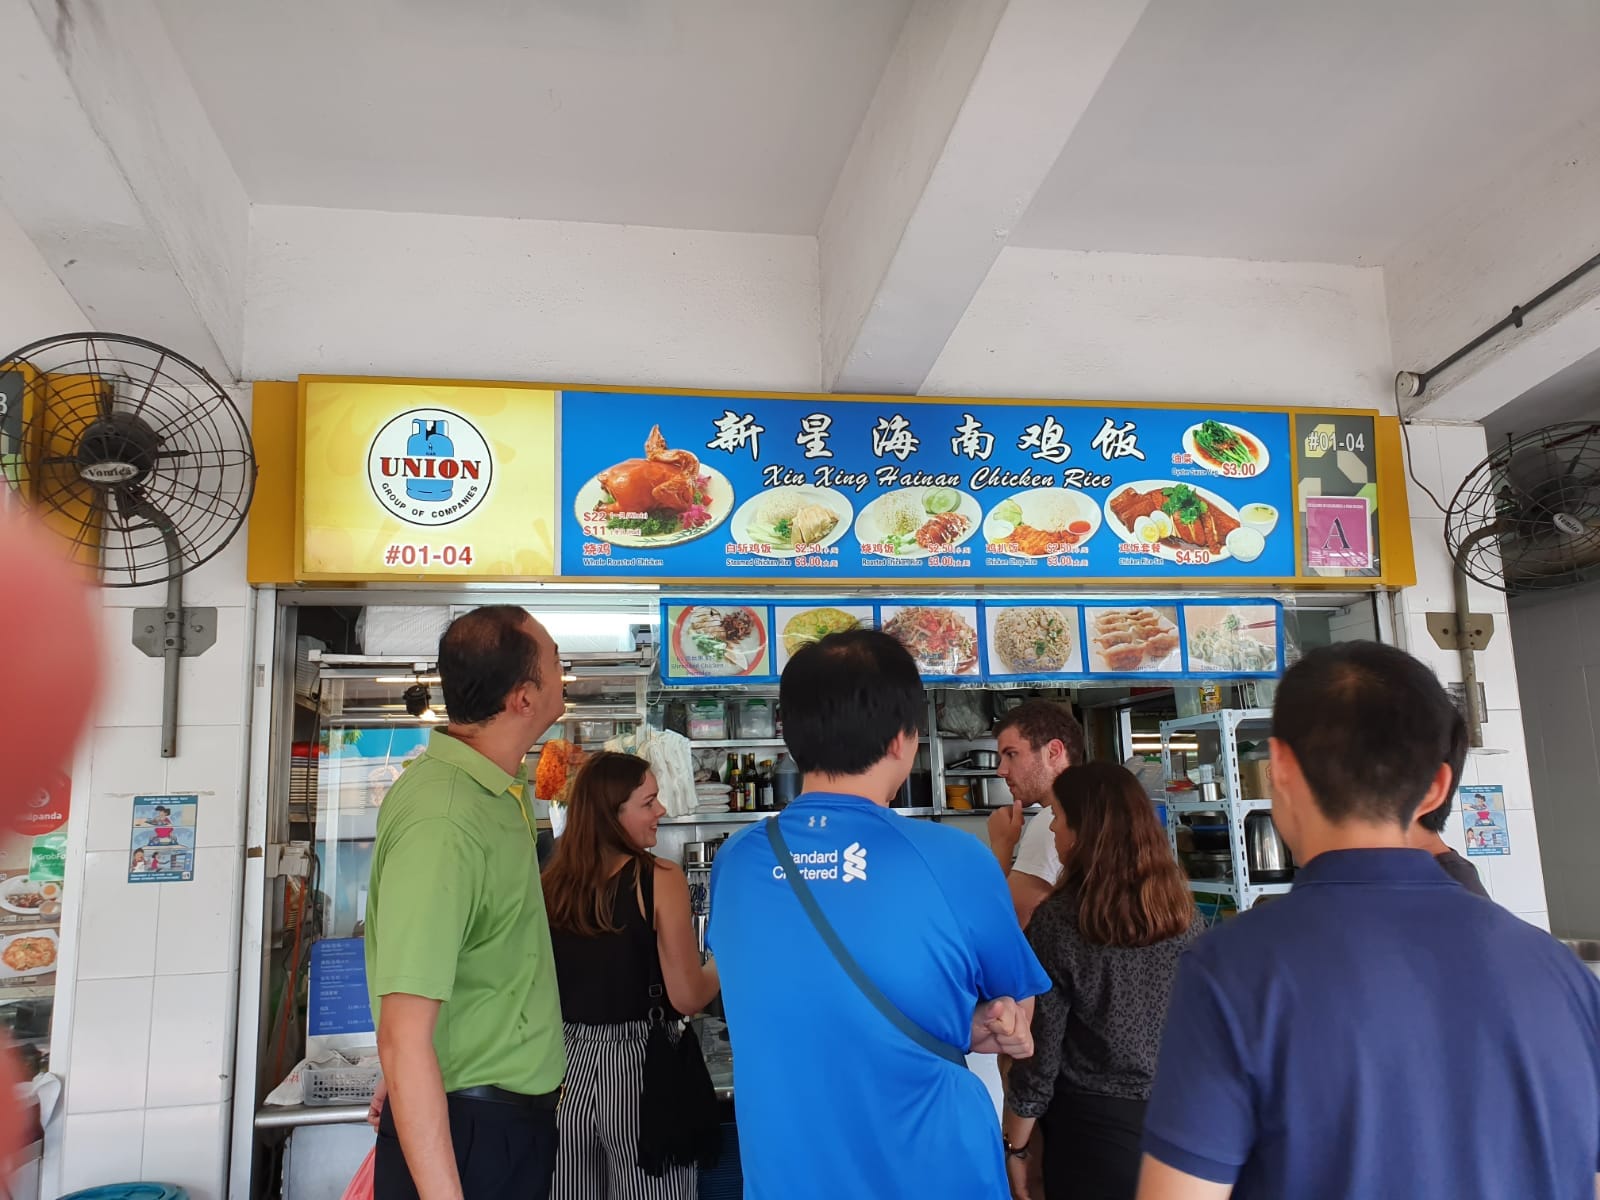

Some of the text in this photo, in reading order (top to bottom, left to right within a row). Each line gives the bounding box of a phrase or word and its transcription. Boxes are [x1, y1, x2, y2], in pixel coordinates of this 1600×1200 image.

[706, 410, 1146, 463] 新星海南鸡饭
[1308, 431, 1365, 452] #01-04
[380, 456, 482, 480] UNION
[1222, 462, 1256, 476] $3.00
[762, 465, 1113, 493] Xin Xing Hainan Chicken Rice
[381, 482, 478, 519] GROUP OF COMPANIES
[583, 511, 606, 522] $22
[583, 525, 606, 536] $11
[1321, 515, 1353, 550] A
[385, 545, 473, 565] #01-04
[795, 543, 820, 553] $2.50
[928, 543, 953, 553] $2.50
[607, 558, 635, 566] Roasted
[636, 558, 663, 566] Chicken
[754, 558, 778, 566] Chicken
[795, 557, 820, 567] $3.00
[862, 558, 886, 566] Roasted
[928, 557, 953, 567] $3.00
[1175, 549, 1210, 565] $4.50
[789, 849, 838, 864] andard
[772, 865, 838, 880] Ctered
